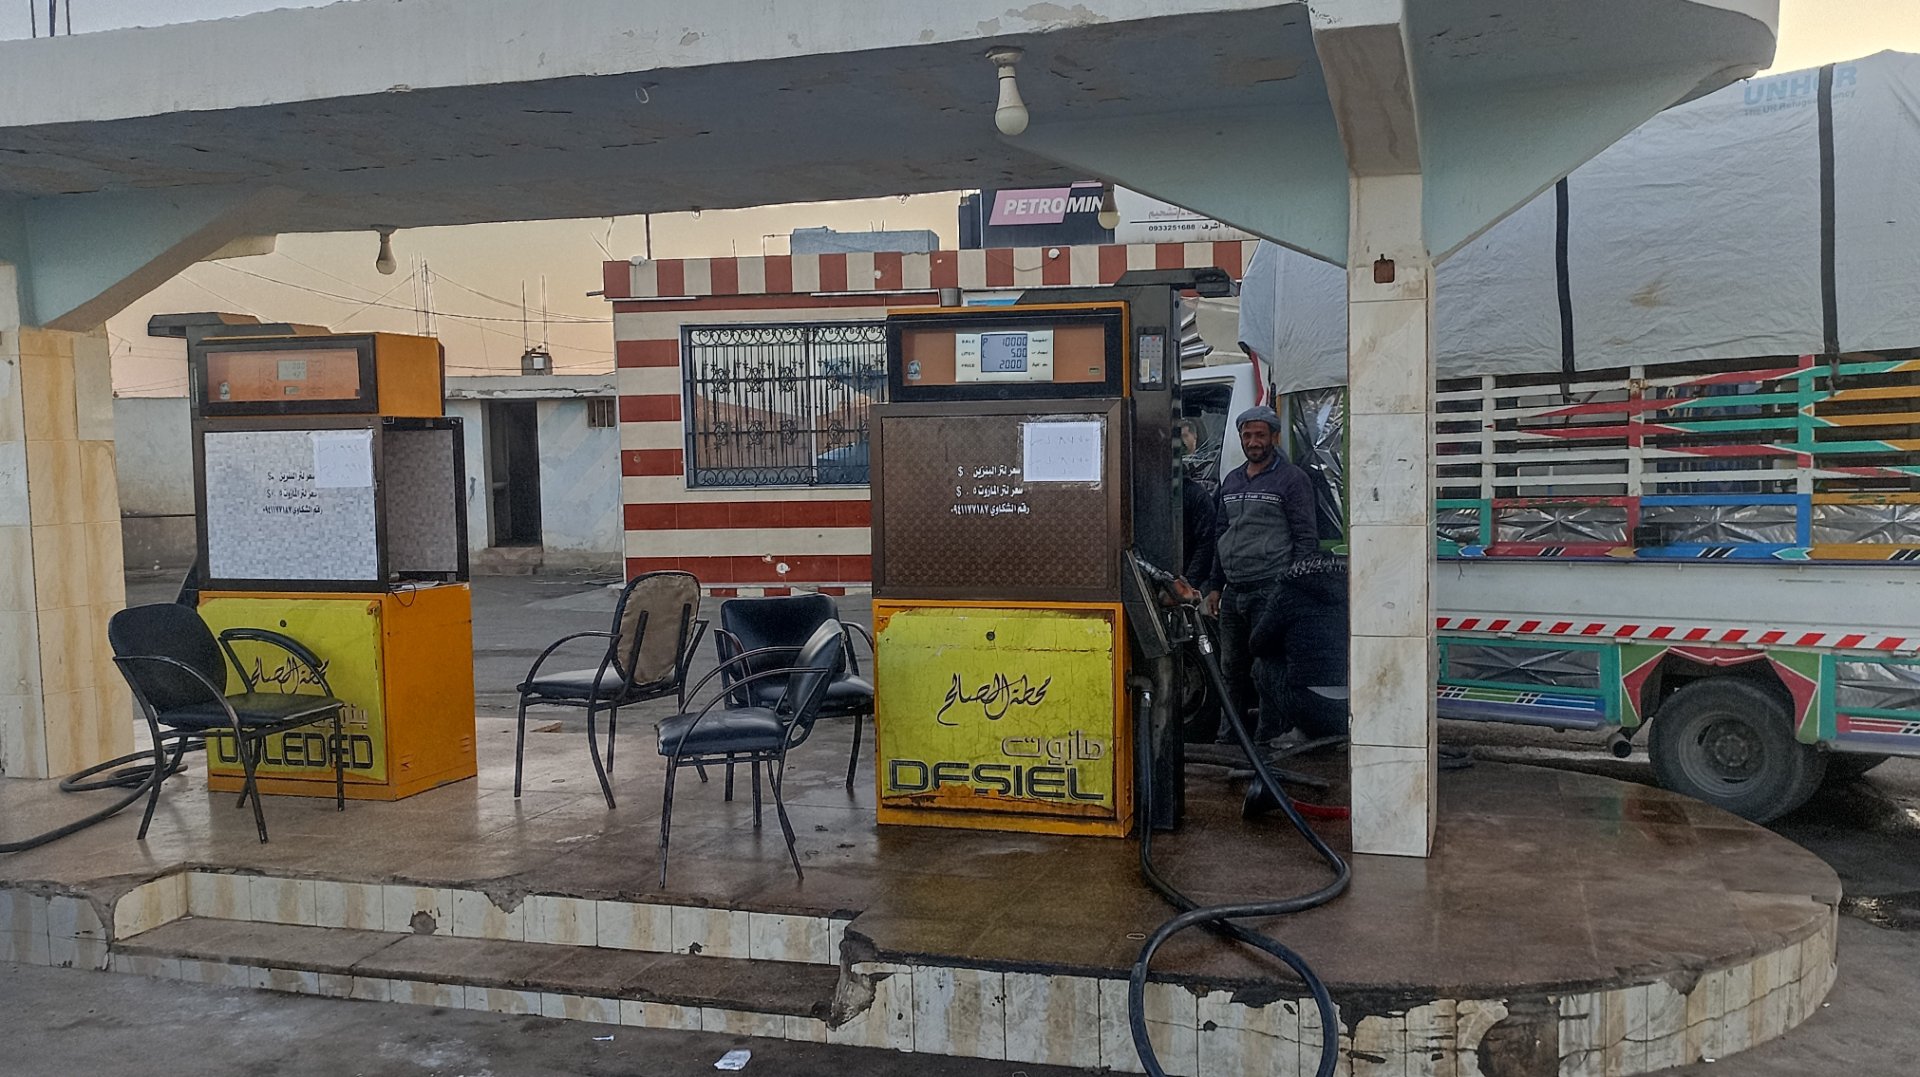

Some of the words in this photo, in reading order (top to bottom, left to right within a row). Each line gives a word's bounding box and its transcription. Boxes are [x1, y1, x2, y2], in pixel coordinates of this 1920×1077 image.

[1002, 336, 1028, 347] 10000
[999, 359, 1022, 369] 2000
[1009, 674, 1052, 706] محطة
[1001, 730, 1106, 765] مازوت
